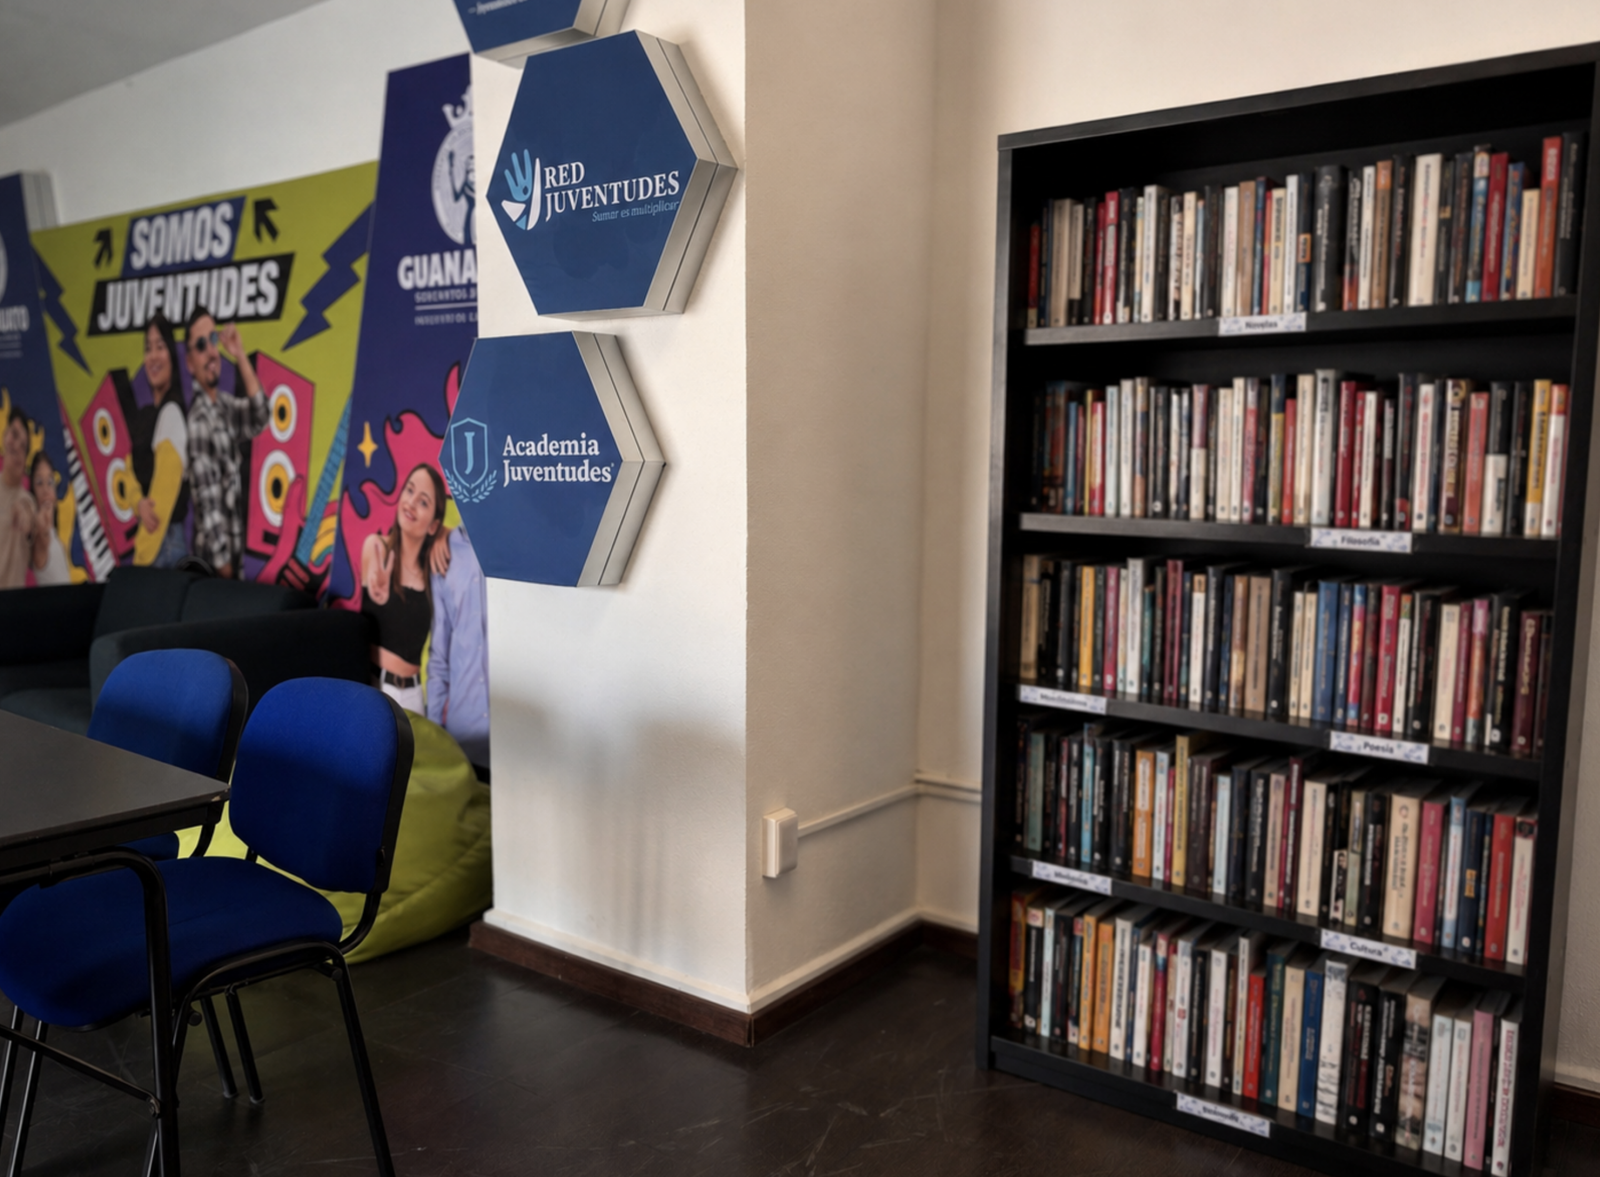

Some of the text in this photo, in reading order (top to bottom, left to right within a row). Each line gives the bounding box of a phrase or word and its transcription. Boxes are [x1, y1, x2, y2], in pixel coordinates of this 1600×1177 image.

[544, 161, 585, 189] RED
[545, 170, 680, 222] JUVENTUDES
[130, 201, 234, 270] SOMOS
[502, 432, 600, 456] Academia
[503, 459, 612, 487] Juventudes
